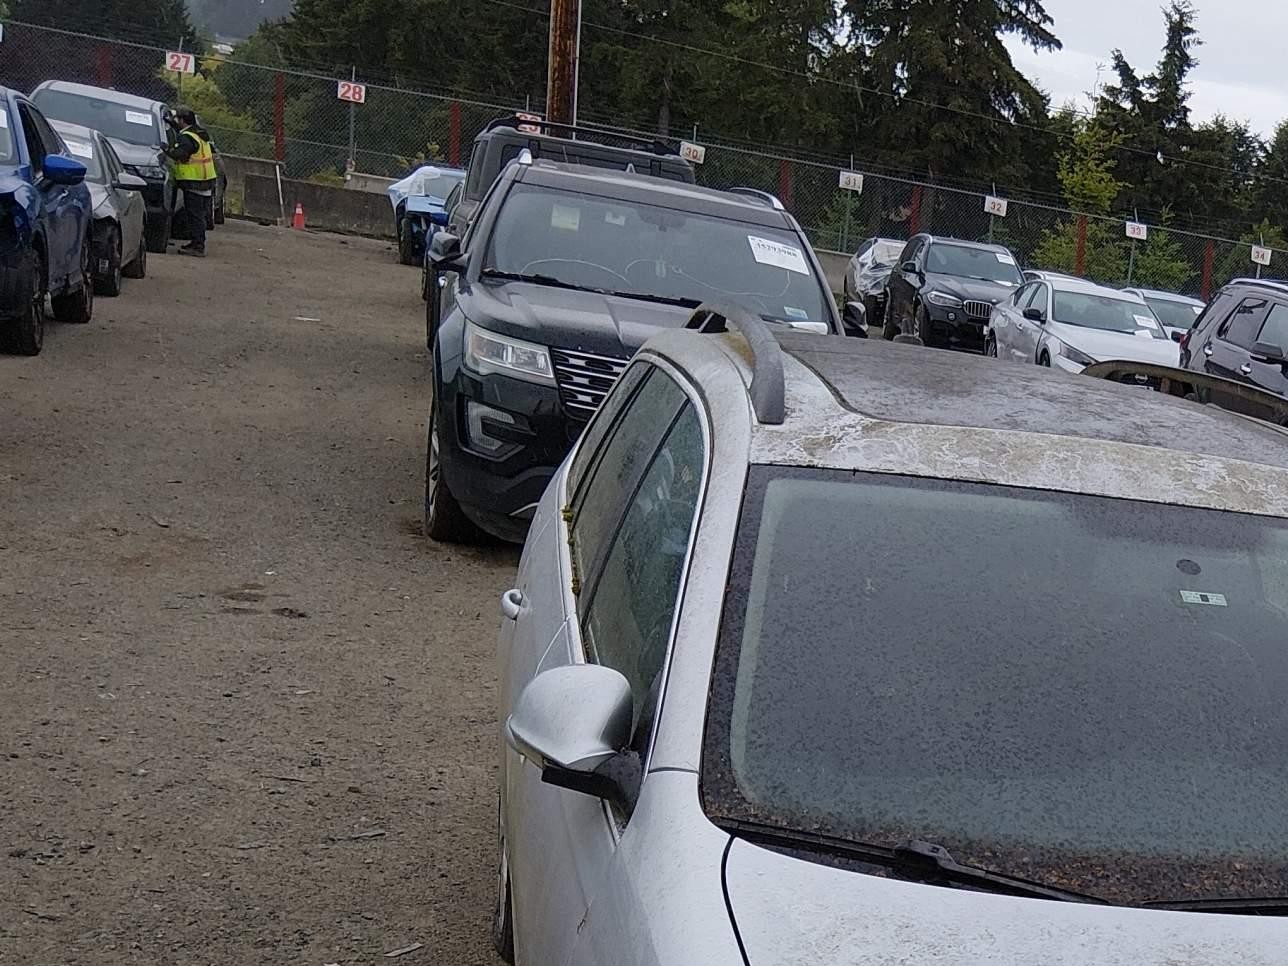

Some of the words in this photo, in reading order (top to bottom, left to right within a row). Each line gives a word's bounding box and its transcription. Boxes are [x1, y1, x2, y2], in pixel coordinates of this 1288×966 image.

[169, 53, 191, 72] 27
[340, 82, 363, 101] 28
[686, 146, 699, 160] 30
[844, 175, 857, 188] 31
[990, 201, 1002, 212] 32
[1254, 250, 1265, 261] 34
